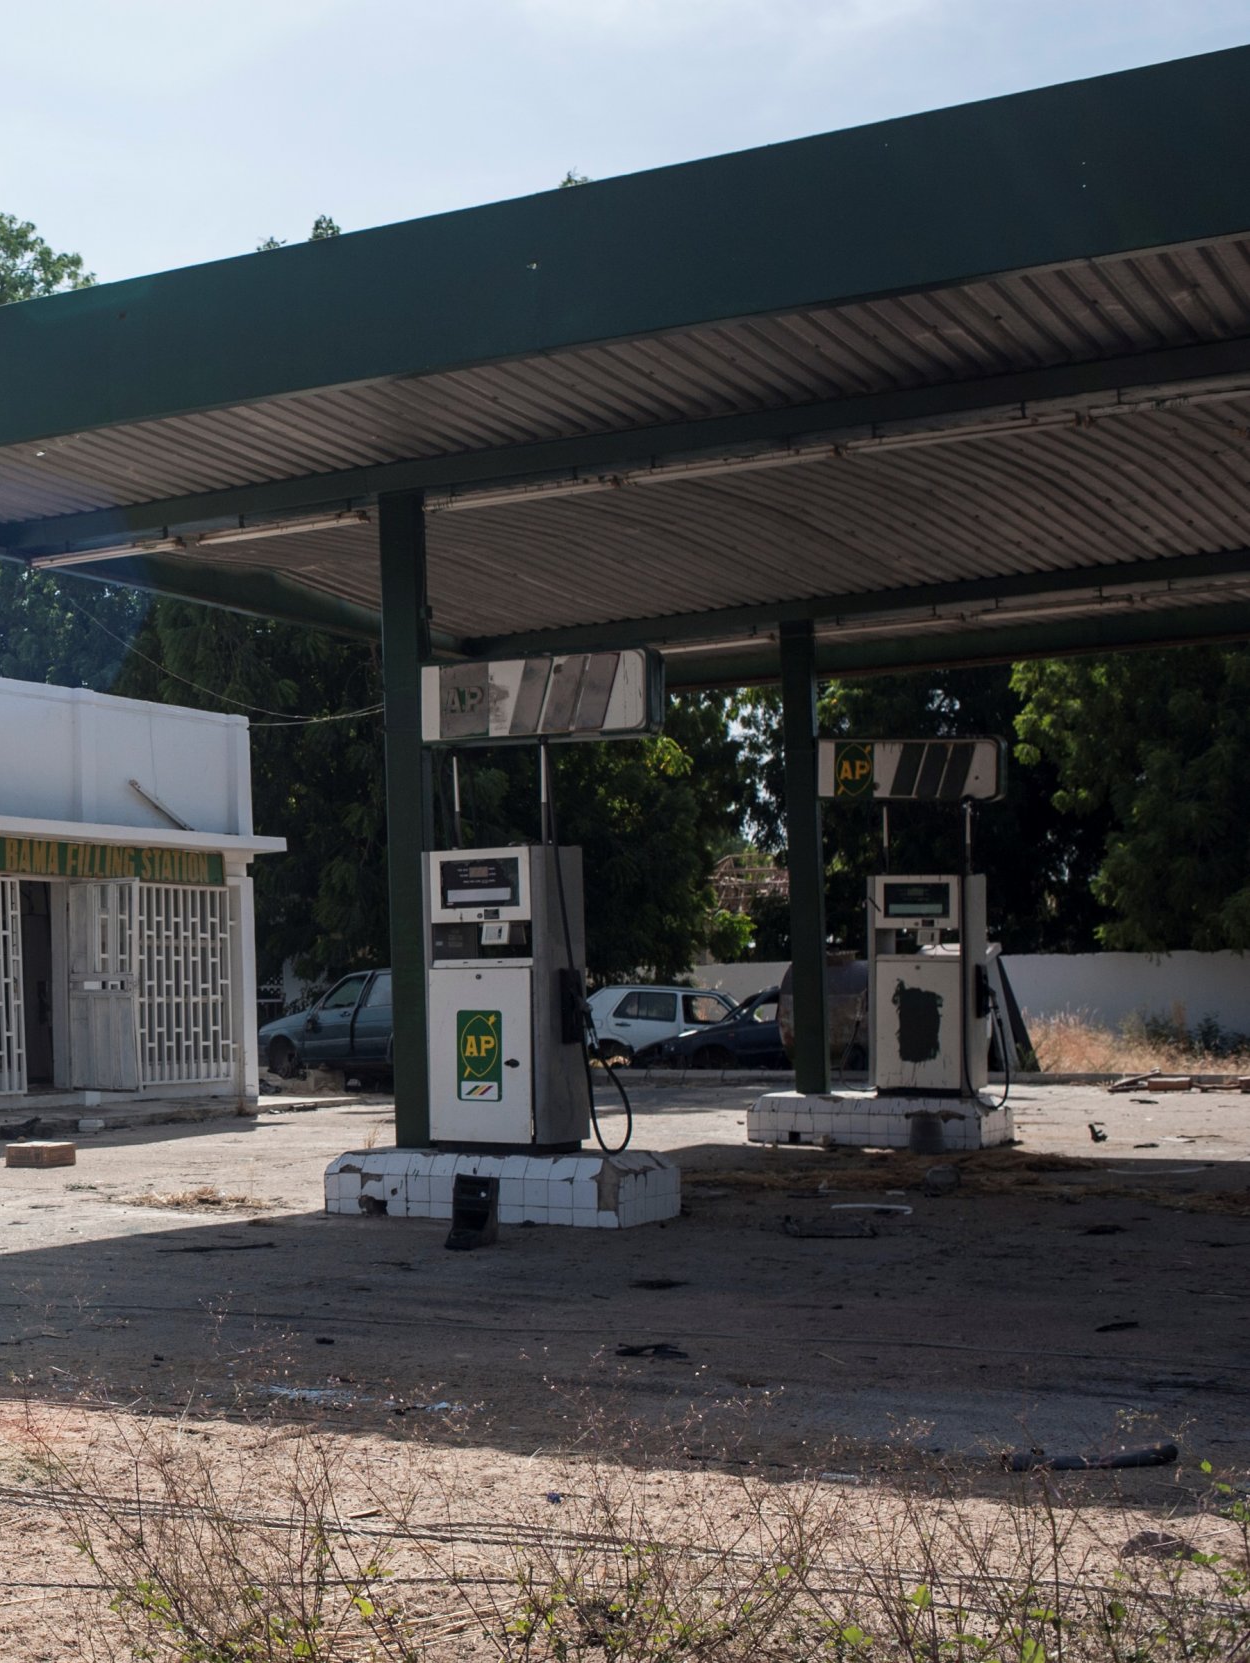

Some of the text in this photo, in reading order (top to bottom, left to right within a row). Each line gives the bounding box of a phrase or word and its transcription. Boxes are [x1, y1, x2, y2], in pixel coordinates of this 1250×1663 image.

[444, 686, 484, 714] AP
[838, 759, 871, 781] AP
[5, 838, 59, 875] BAMA
[65, 843, 136, 878] FILLING
[141, 848, 210, 883] STATION
[465, 1035, 495, 1057] AP
